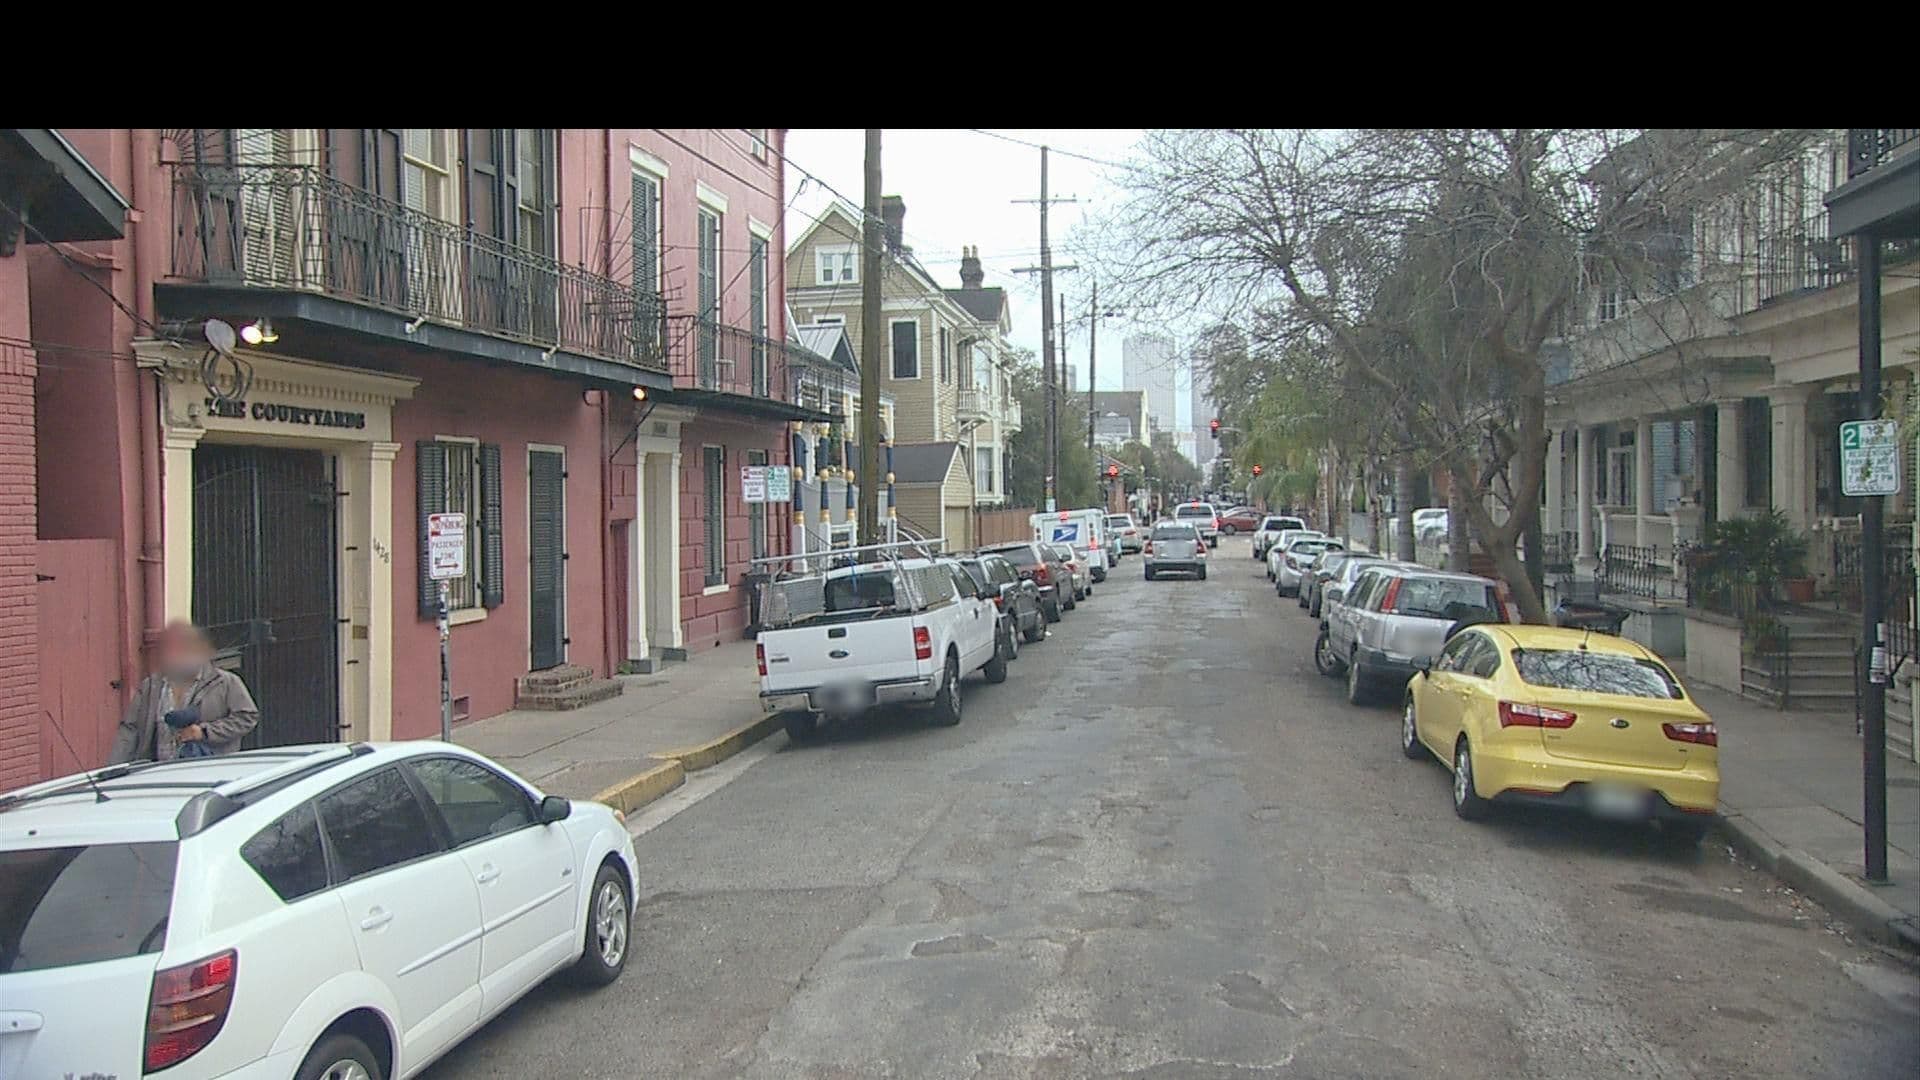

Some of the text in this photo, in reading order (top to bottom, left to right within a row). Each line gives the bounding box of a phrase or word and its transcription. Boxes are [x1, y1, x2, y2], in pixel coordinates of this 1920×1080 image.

[204, 398, 365, 429] THE COURTYARDS
[1844, 429, 1856, 447] 2
